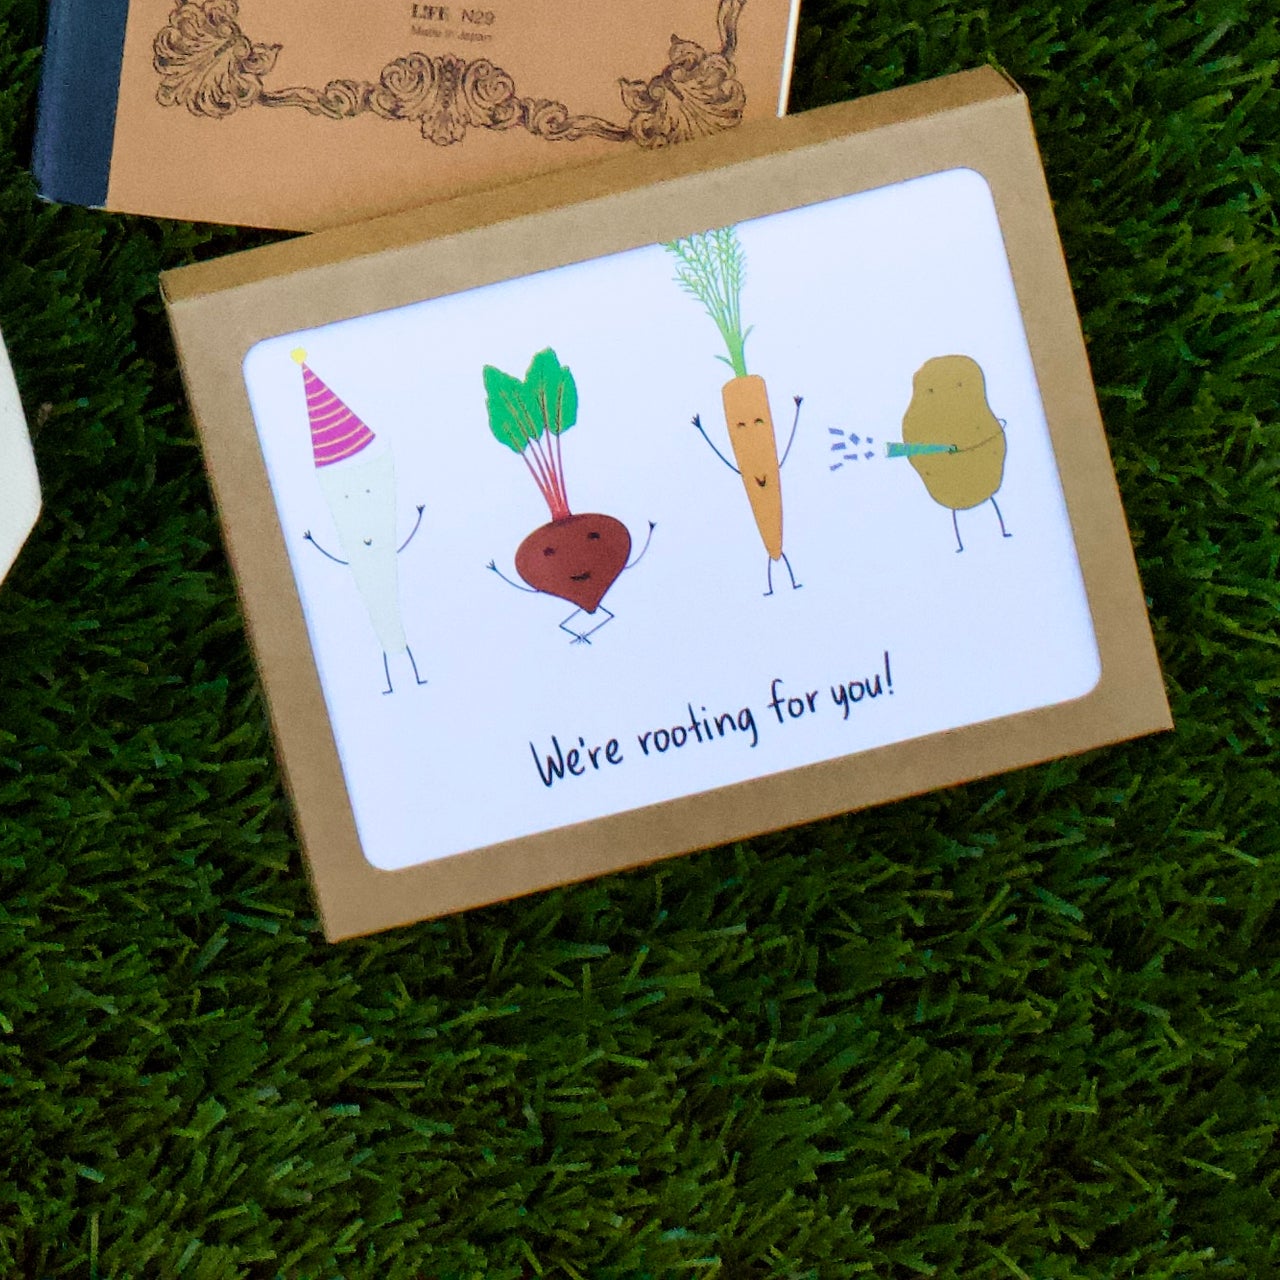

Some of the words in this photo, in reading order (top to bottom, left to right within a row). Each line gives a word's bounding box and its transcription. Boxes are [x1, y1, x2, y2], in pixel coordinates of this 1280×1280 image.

[529, 734, 624, 789] We're
[637, 702, 759, 755] rooting
[767, 678, 820, 724] for
[830, 650, 895, 721] you!
